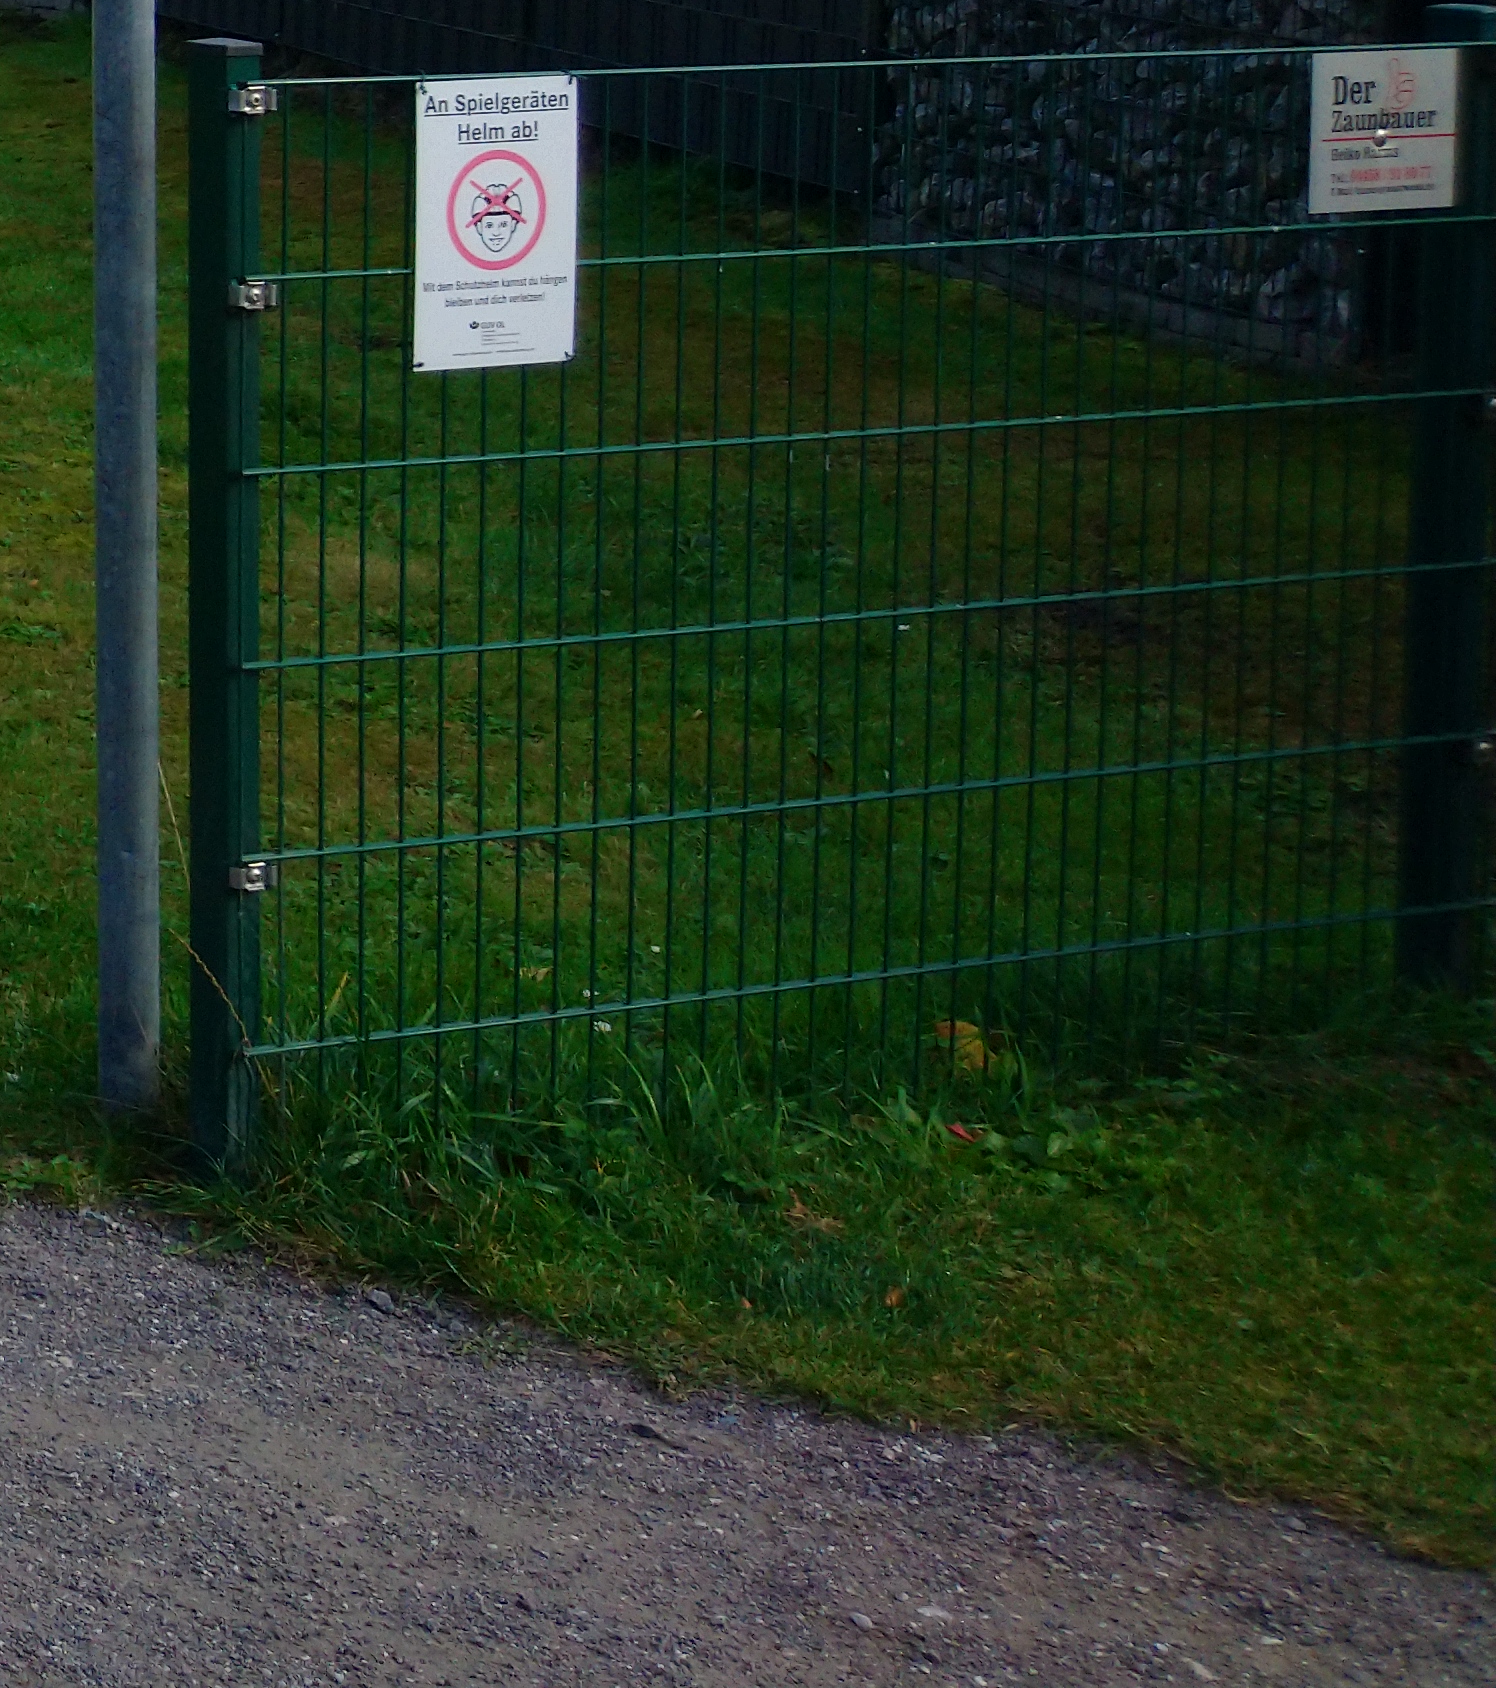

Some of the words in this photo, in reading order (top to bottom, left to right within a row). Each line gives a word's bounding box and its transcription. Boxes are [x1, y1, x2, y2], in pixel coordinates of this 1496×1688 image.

[424, 95, 448, 112] An
[455, 90, 569, 116] Spielgeräten
[1331, 76, 1376, 105] Der
[458, 123, 504, 141] Helm
[512, 121, 538, 138] ab!
[1331, 108, 1438, 133] Zaunbauer
